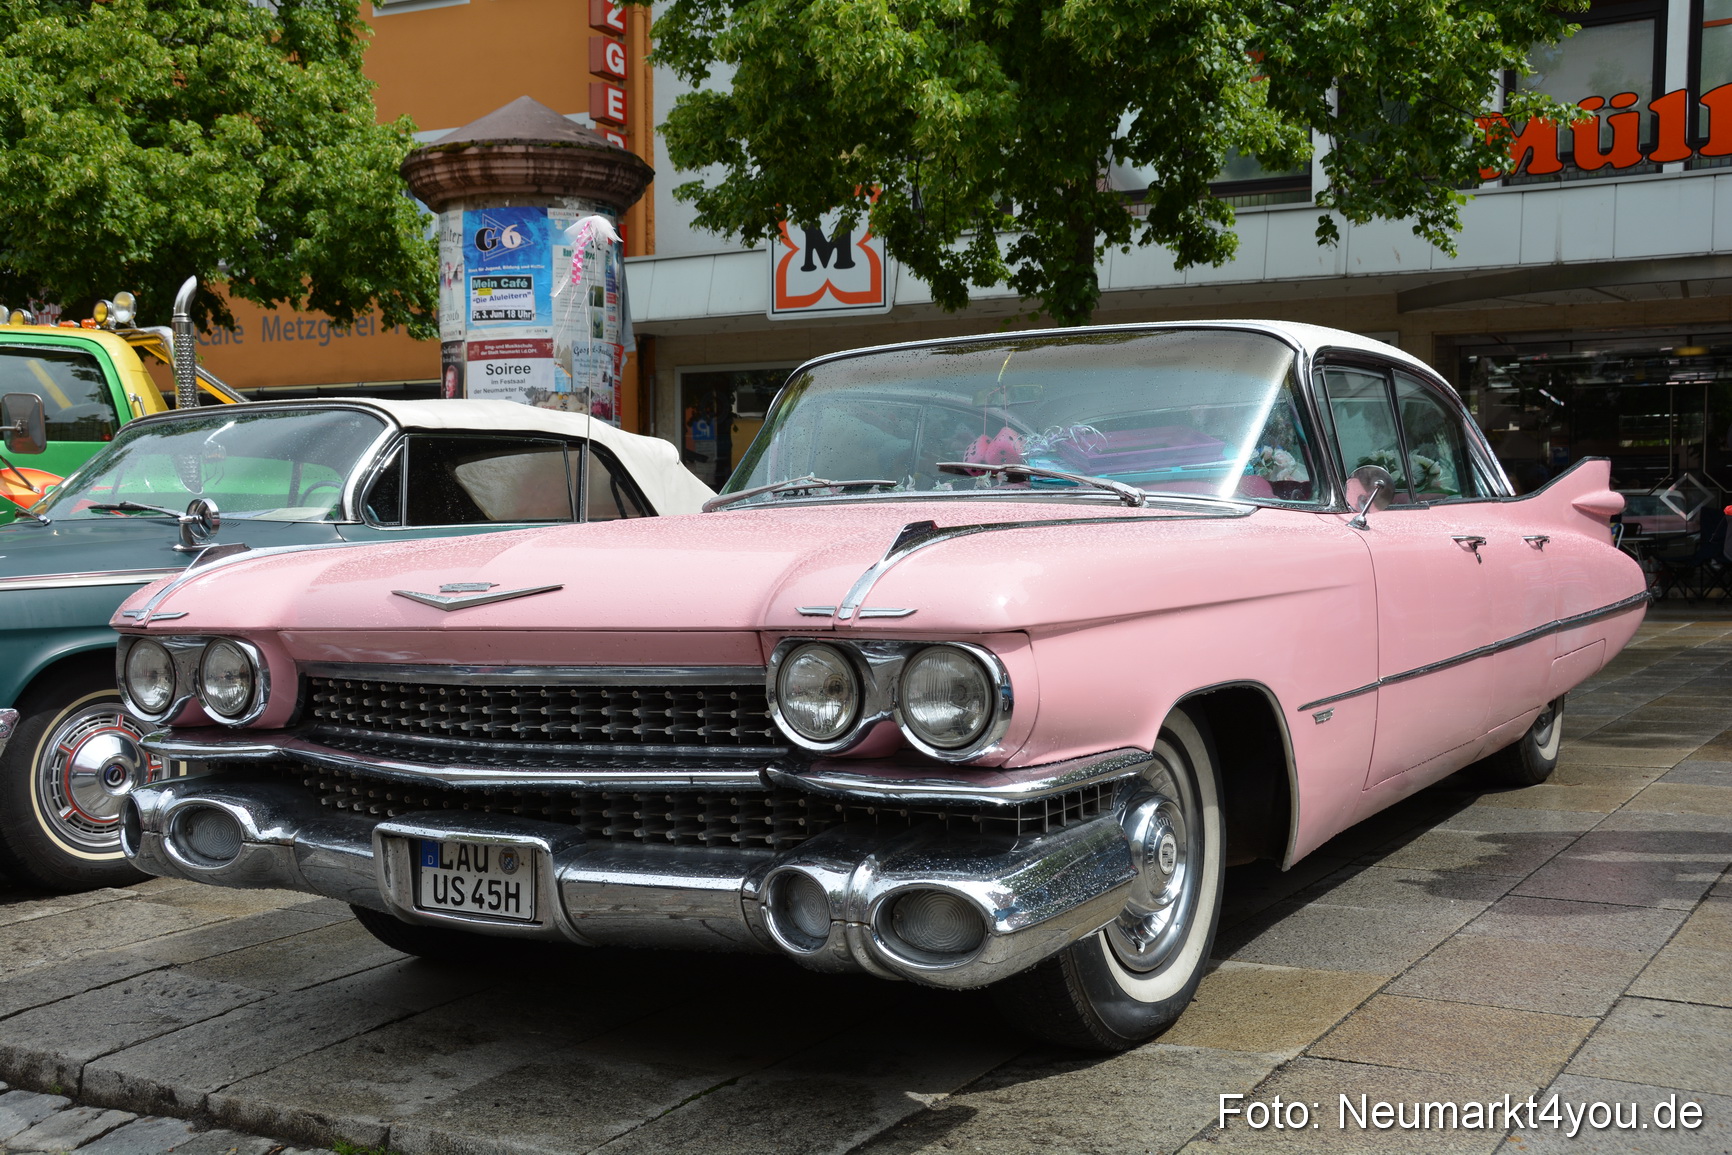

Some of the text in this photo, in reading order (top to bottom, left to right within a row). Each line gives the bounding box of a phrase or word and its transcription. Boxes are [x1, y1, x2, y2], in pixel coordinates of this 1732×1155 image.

[472, 278, 528, 289] Mein Café
[472, 310, 532, 319] Fr. 3. Juni 18 Uhr
[485, 363, 531, 376] Soiree
[427, 854, 434, 866] D
[439, 841, 489, 873] LAU
[433, 873, 520, 914] US 45H
